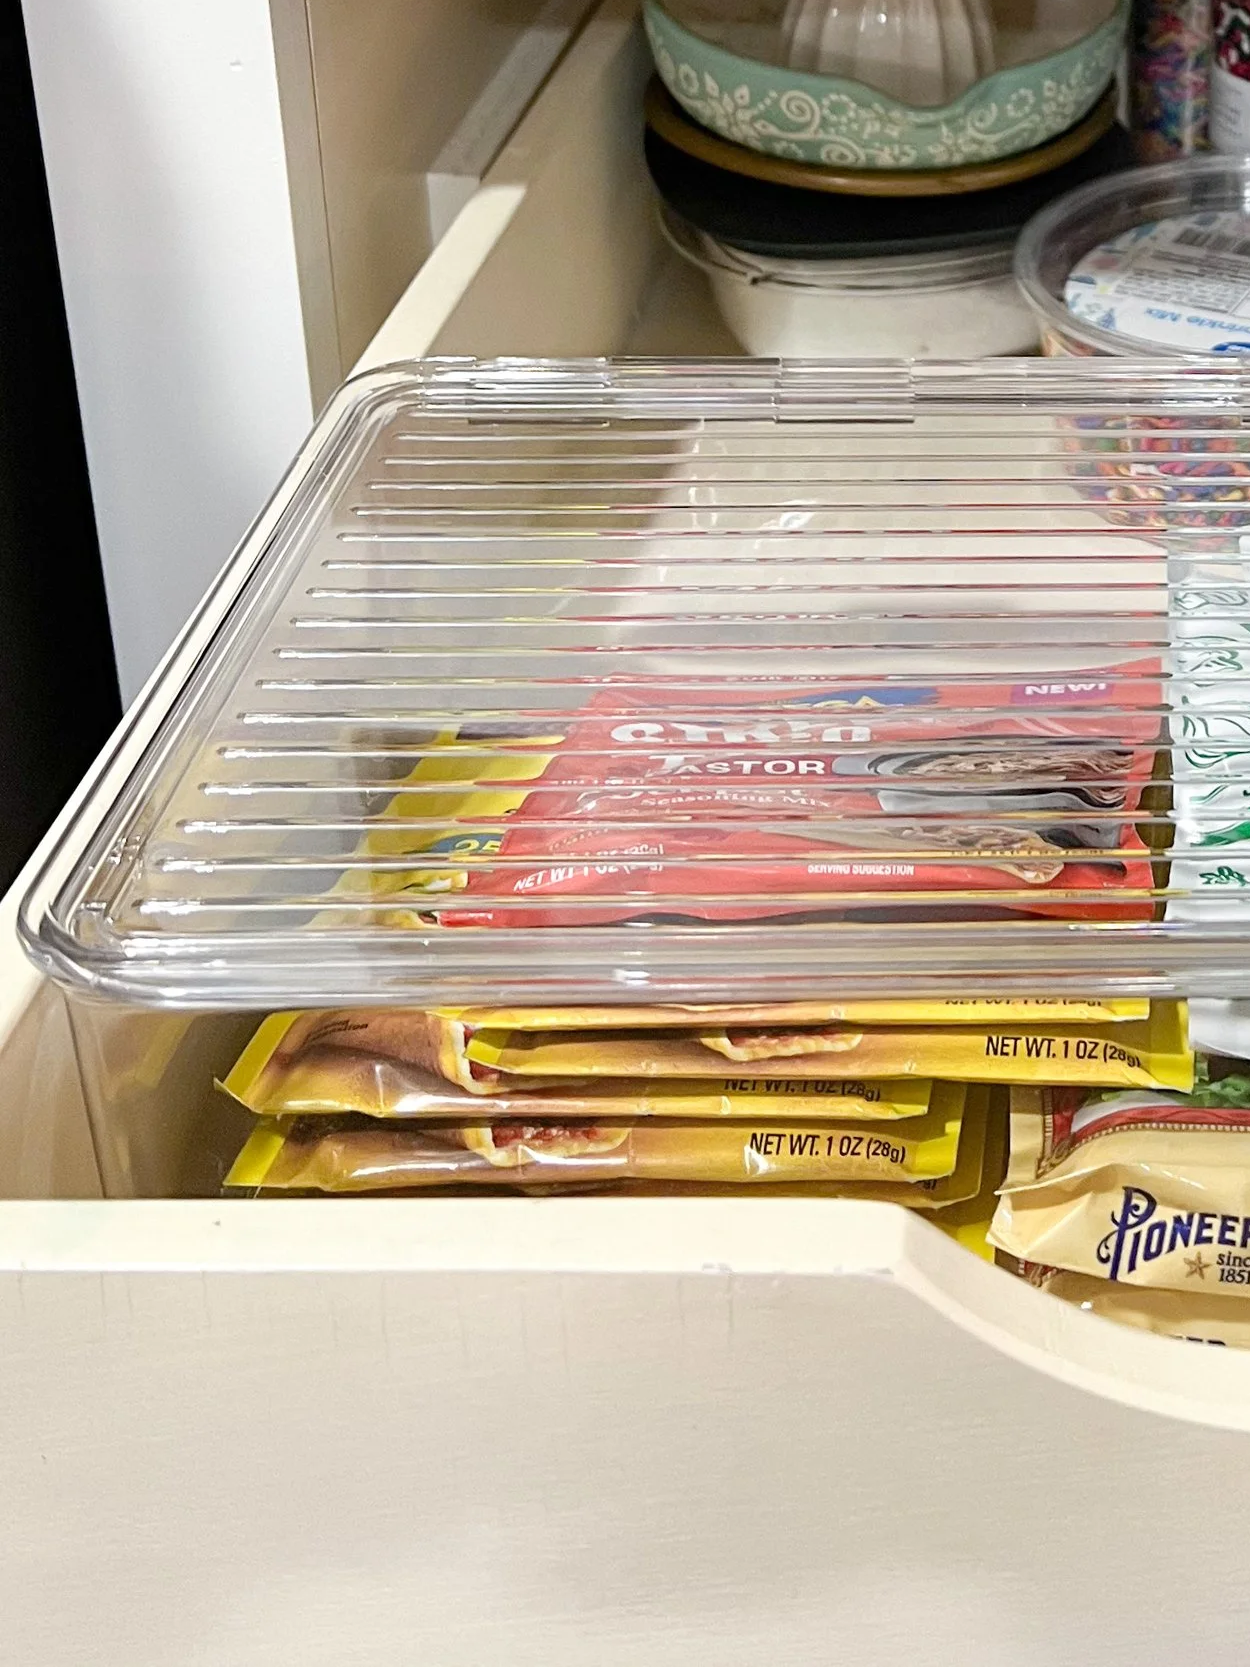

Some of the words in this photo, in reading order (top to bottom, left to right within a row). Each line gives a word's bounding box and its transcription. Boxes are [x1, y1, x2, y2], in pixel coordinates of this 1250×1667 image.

[1144, 307, 1182, 323] Mix
[986, 1036, 1022, 1058] NET
[1025, 1037, 1056, 1059] WT.
[1063, 1040, 1069, 1058] 1
[1076, 1040, 1099, 1060] OZ
[1102, 1042, 1141, 1068] (28g)
[750, 1132, 786, 1156] NET
[789, 1134, 820, 1157] WT.
[826, 1135, 833, 1157] 1
[839, 1136, 864, 1157] OZ
[866, 1137, 907, 1164] (28g)
